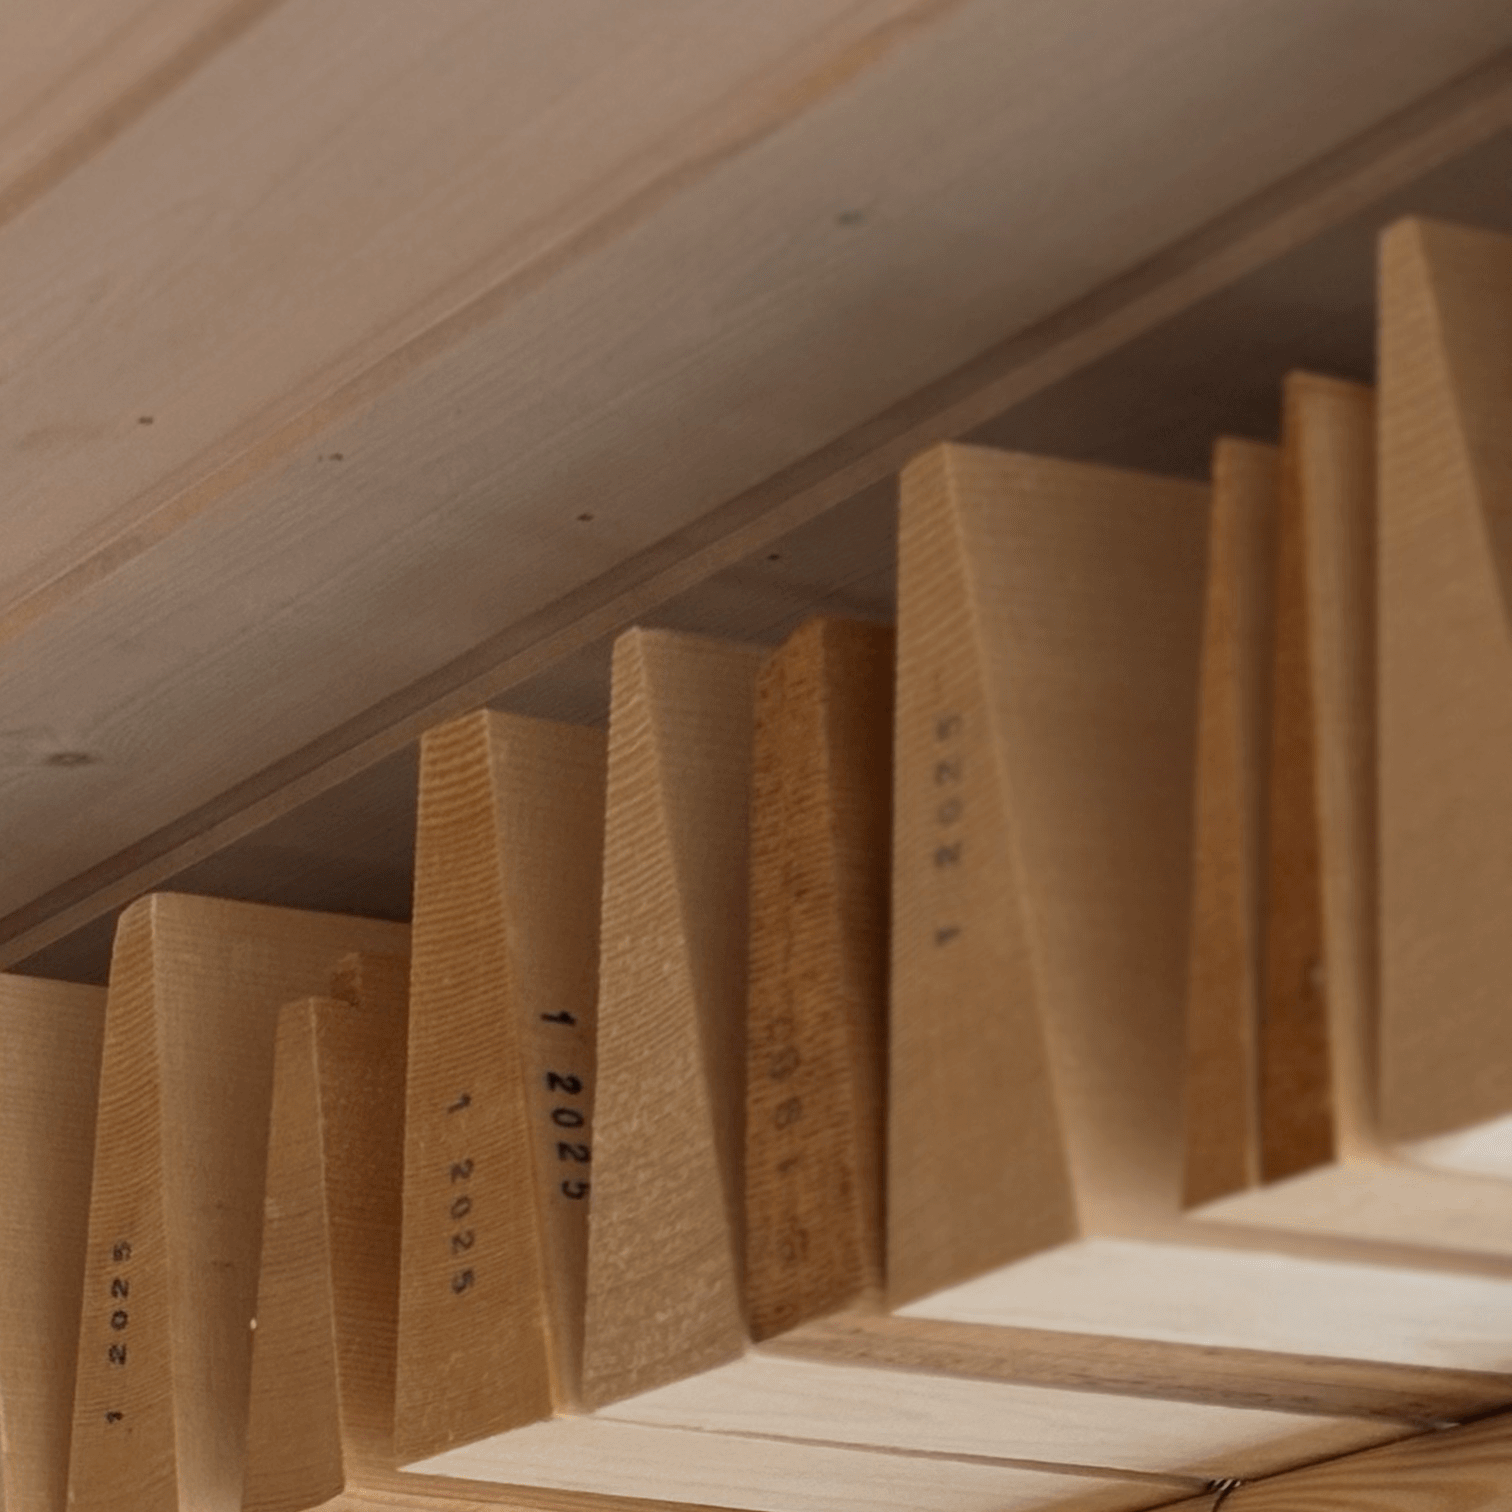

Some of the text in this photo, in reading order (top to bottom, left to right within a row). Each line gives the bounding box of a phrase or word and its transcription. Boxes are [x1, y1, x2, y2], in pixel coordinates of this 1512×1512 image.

[447, 1092, 475, 1294] 1 2025
[540, 1010, 591, 1201] 1 2025
[107, 1240, 132, 1366] 2025
